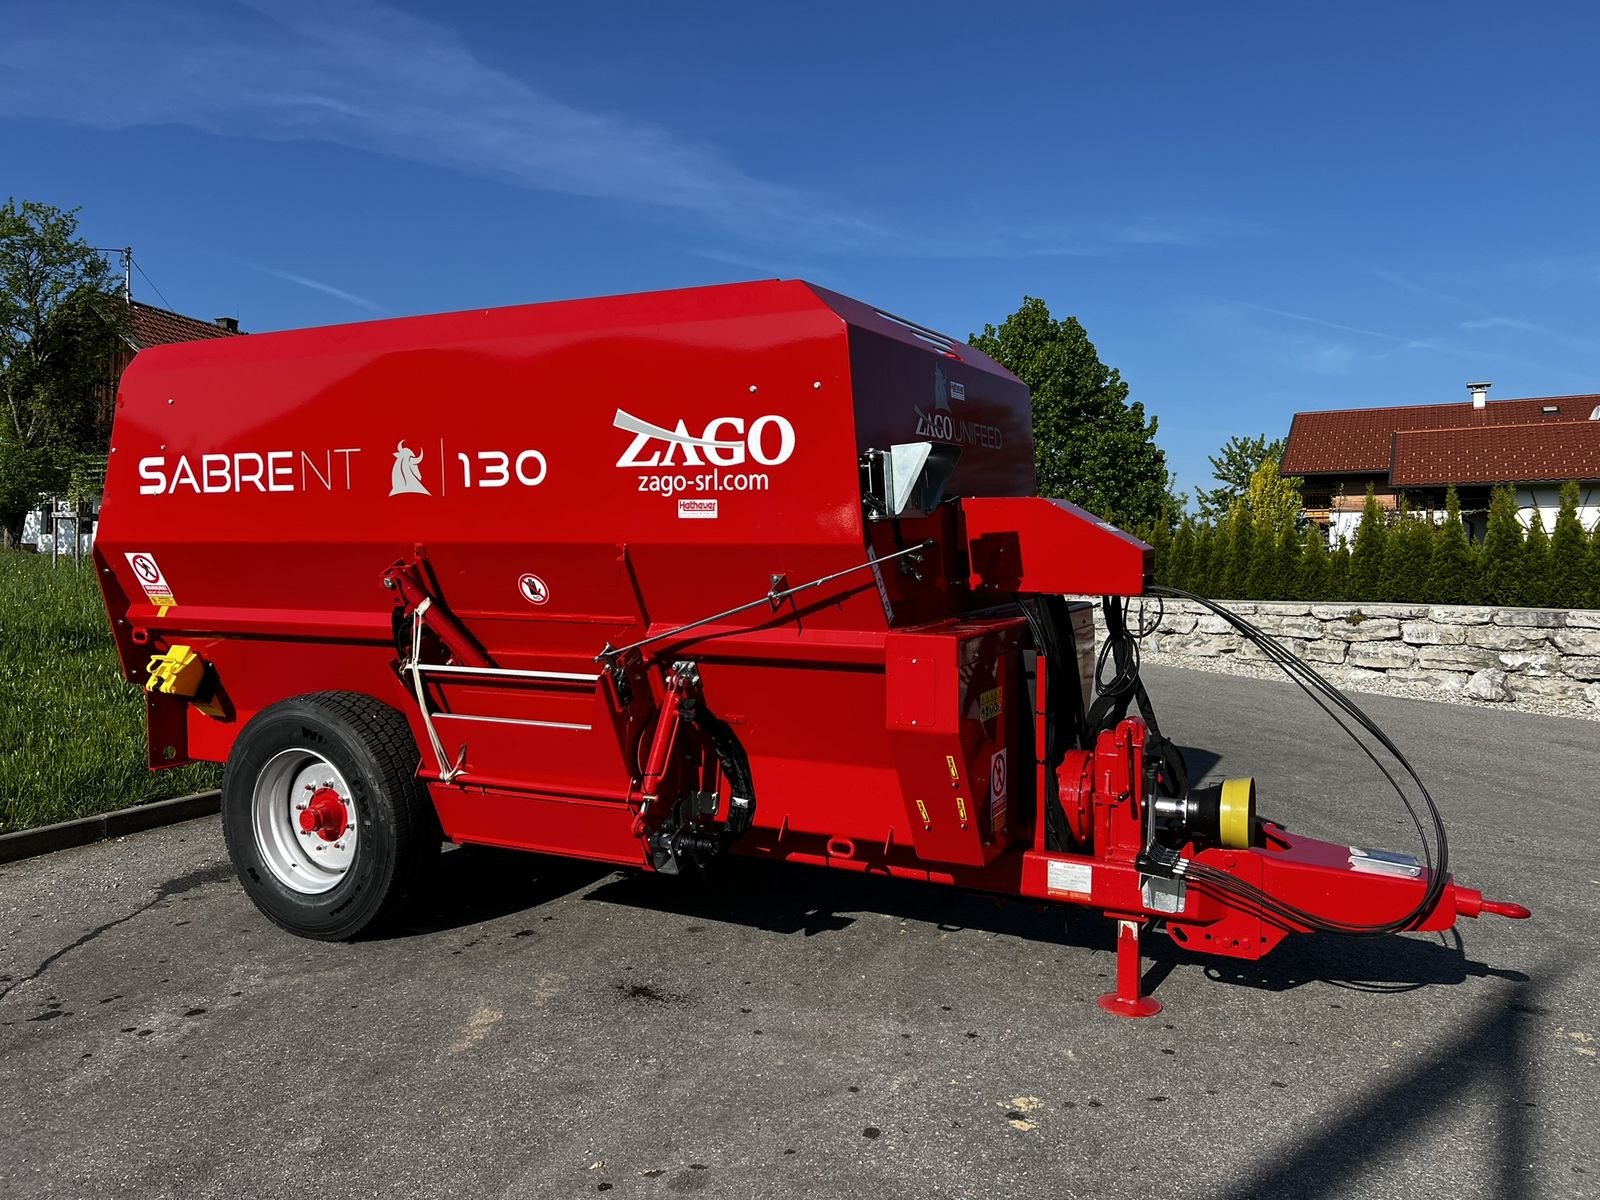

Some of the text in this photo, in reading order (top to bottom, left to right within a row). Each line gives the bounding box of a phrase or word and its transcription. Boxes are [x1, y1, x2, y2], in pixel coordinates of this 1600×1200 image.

[613, 407, 795, 468] ZAGO
[914, 405, 1003, 451] ZAGO UNIFEED
[457, 449, 547, 488] 130
[638, 467, 769, 498] zago-srl.com
